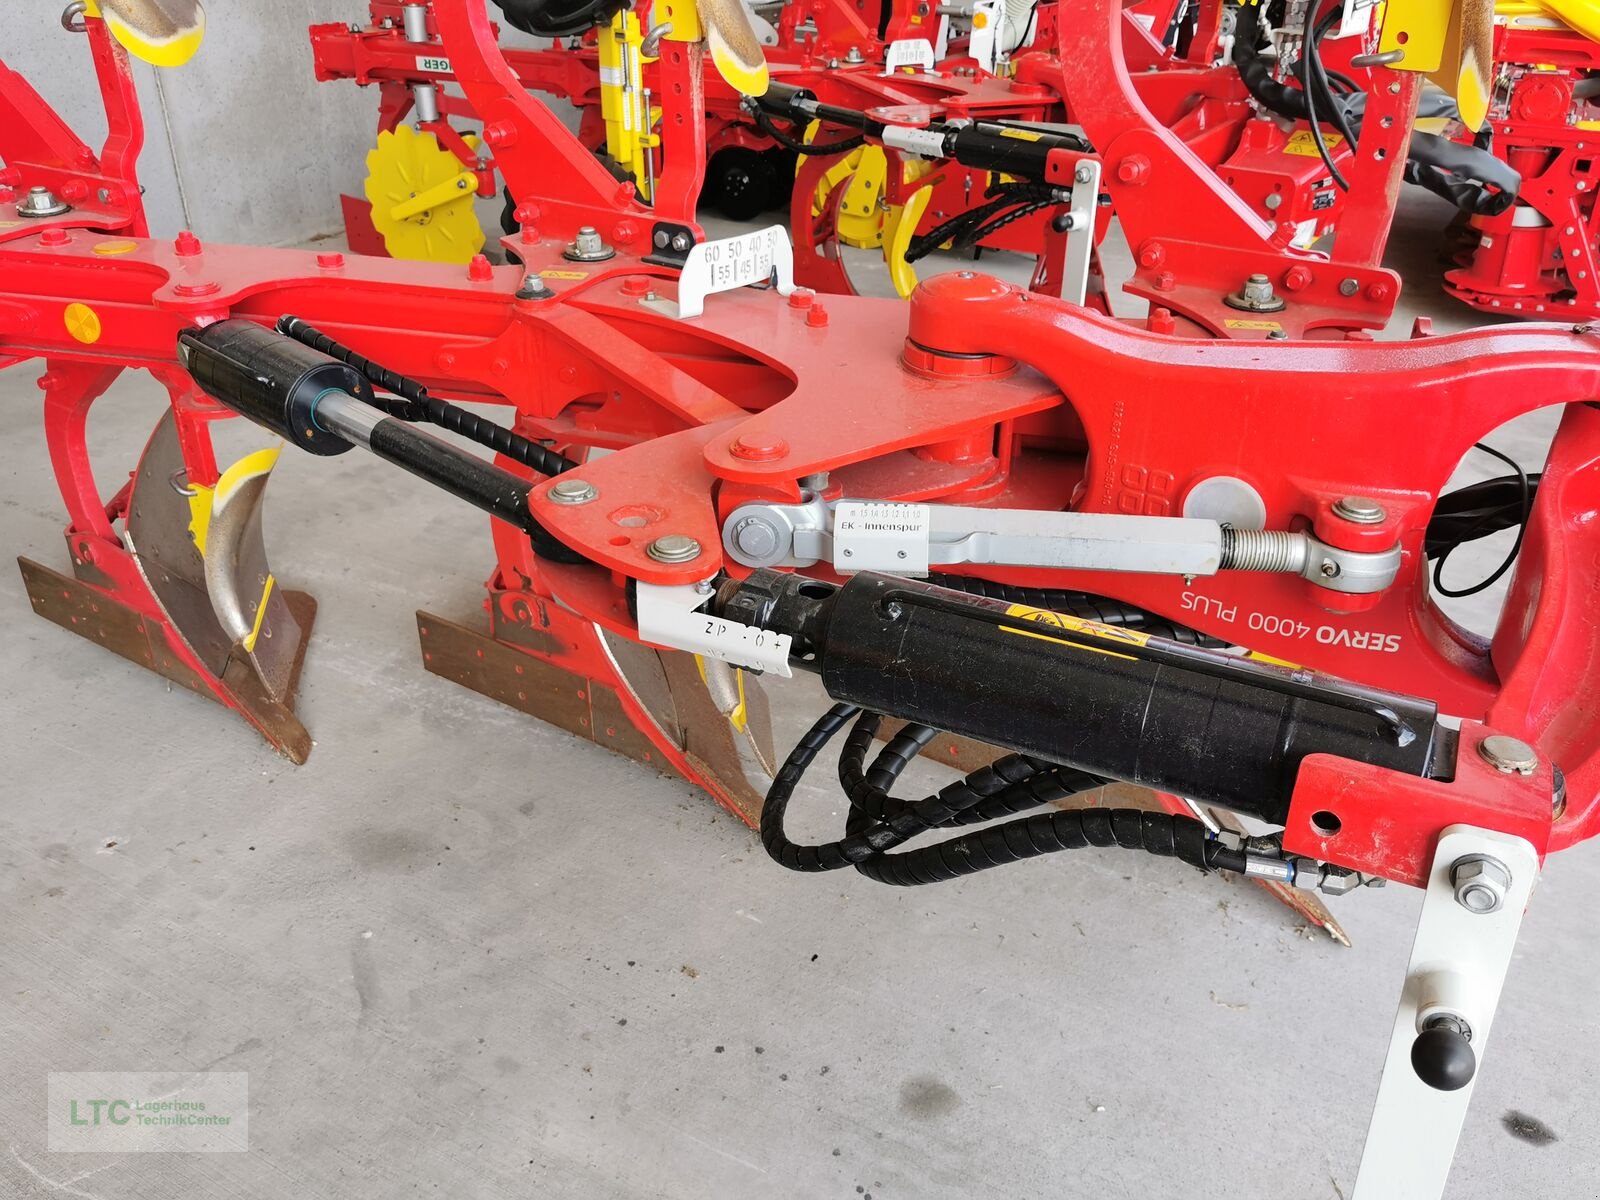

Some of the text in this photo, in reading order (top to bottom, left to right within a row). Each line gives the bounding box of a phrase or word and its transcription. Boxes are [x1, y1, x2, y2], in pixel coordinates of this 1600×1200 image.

[424, 59, 451, 71] GER
[705, 245, 720, 263] 60
[729, 240, 742, 258] 50
[749, 235, 761, 252] 40
[718, 265, 730, 280] 55
[740, 259, 752, 274] 45
[841, 522, 855, 530] EK
[865, 522, 922, 532] Innenspur
[1180, 591, 1402, 653] SERVO 4000 PLUS
